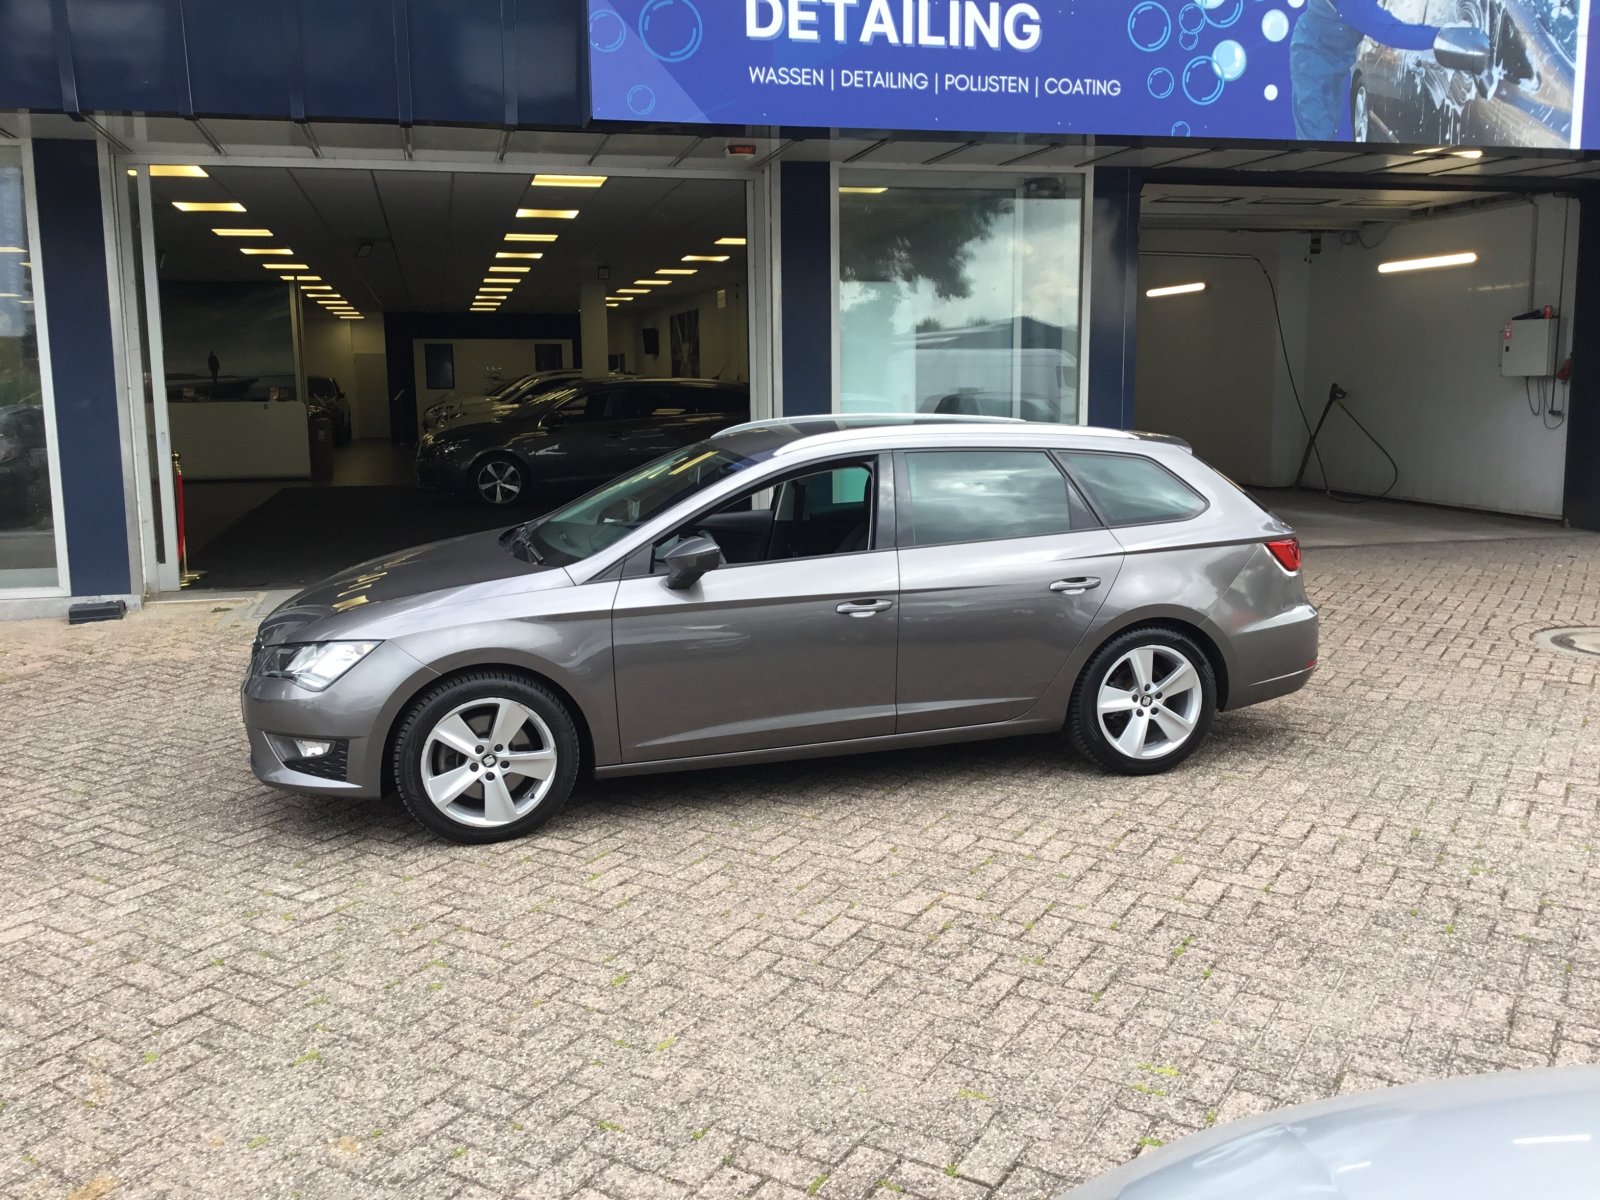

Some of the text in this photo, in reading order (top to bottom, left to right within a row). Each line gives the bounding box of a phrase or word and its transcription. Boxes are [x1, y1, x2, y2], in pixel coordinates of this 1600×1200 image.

[745, 0, 1042, 51] DETAILING
[748, 66, 825, 87] WASSEN
[841, 69, 929, 90] DETAILING
[944, 73, 1030, 94] POLIJSTEN
[1044, 77, 1122, 97] COATING
